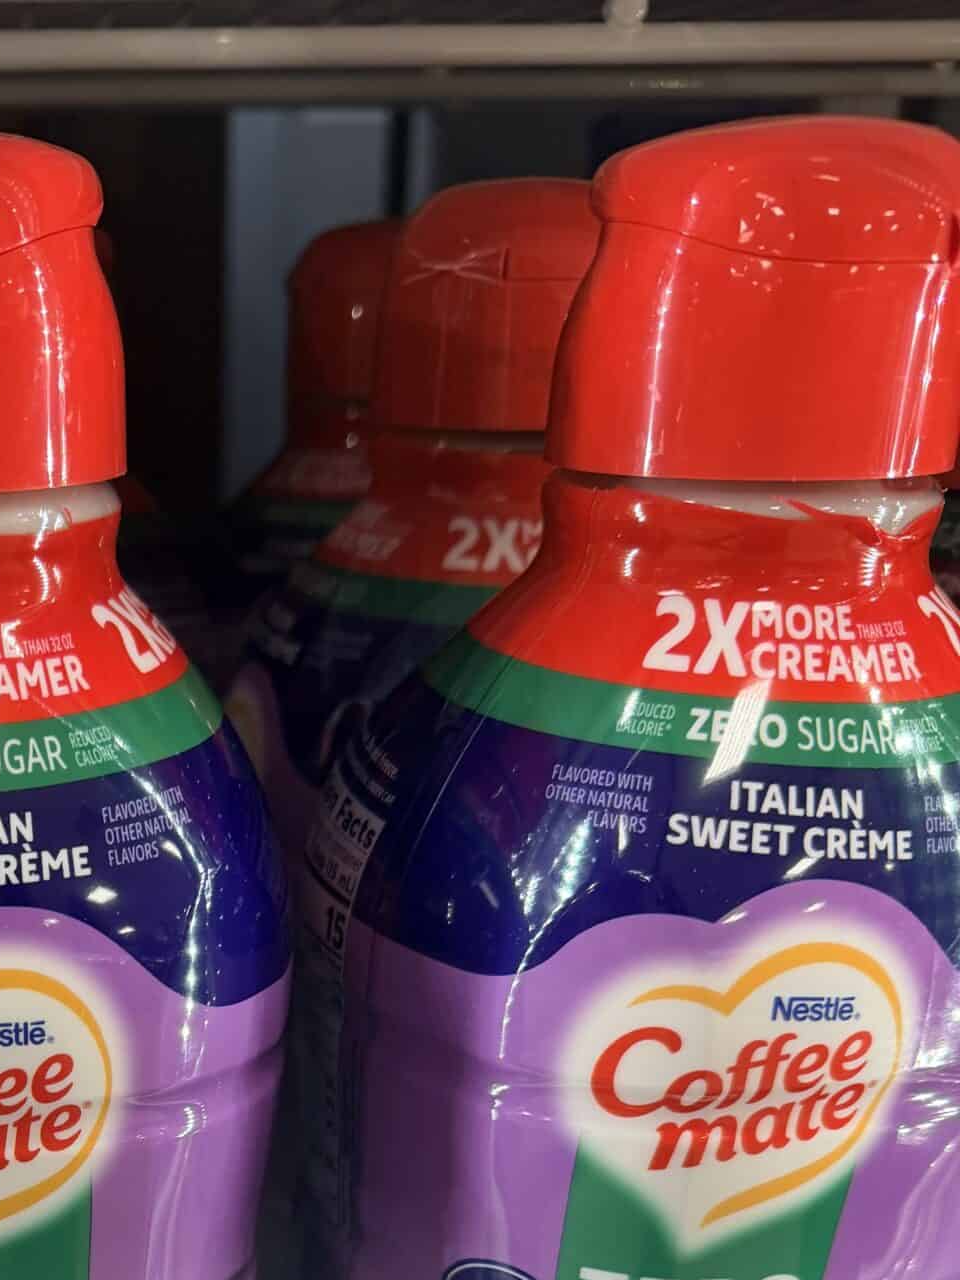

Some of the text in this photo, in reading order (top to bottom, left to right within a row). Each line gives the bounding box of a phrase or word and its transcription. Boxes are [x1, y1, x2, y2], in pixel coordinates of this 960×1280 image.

[442, 516, 524, 574] 2X
[642, 596, 753, 678] 2X
[750, 602, 856, 641] MORE
[750, 641, 922, 683] CREAMER
[624, 700, 677, 721] DUCED
[68, 725, 113, 749] REDUCED
[686, 707, 788, 748] ZEO
[797, 715, 898, 756] SUGAR
[551, 763, 653, 793] FLAVORED WITH
[101, 795, 156, 825] FLAVORED
[545, 783, 649, 813] OTHER NATURAL
[729, 780, 864, 821] ITALIAN
[104, 821, 145, 845] OTHER
[665, 813, 914, 861] SWEET CRÈME
[108, 840, 159, 867] FLAVORS
[771, 996, 856, 1021] Nestlé
[590, 1025, 874, 1118] Coffee
[647, 1082, 867, 1171] mate
